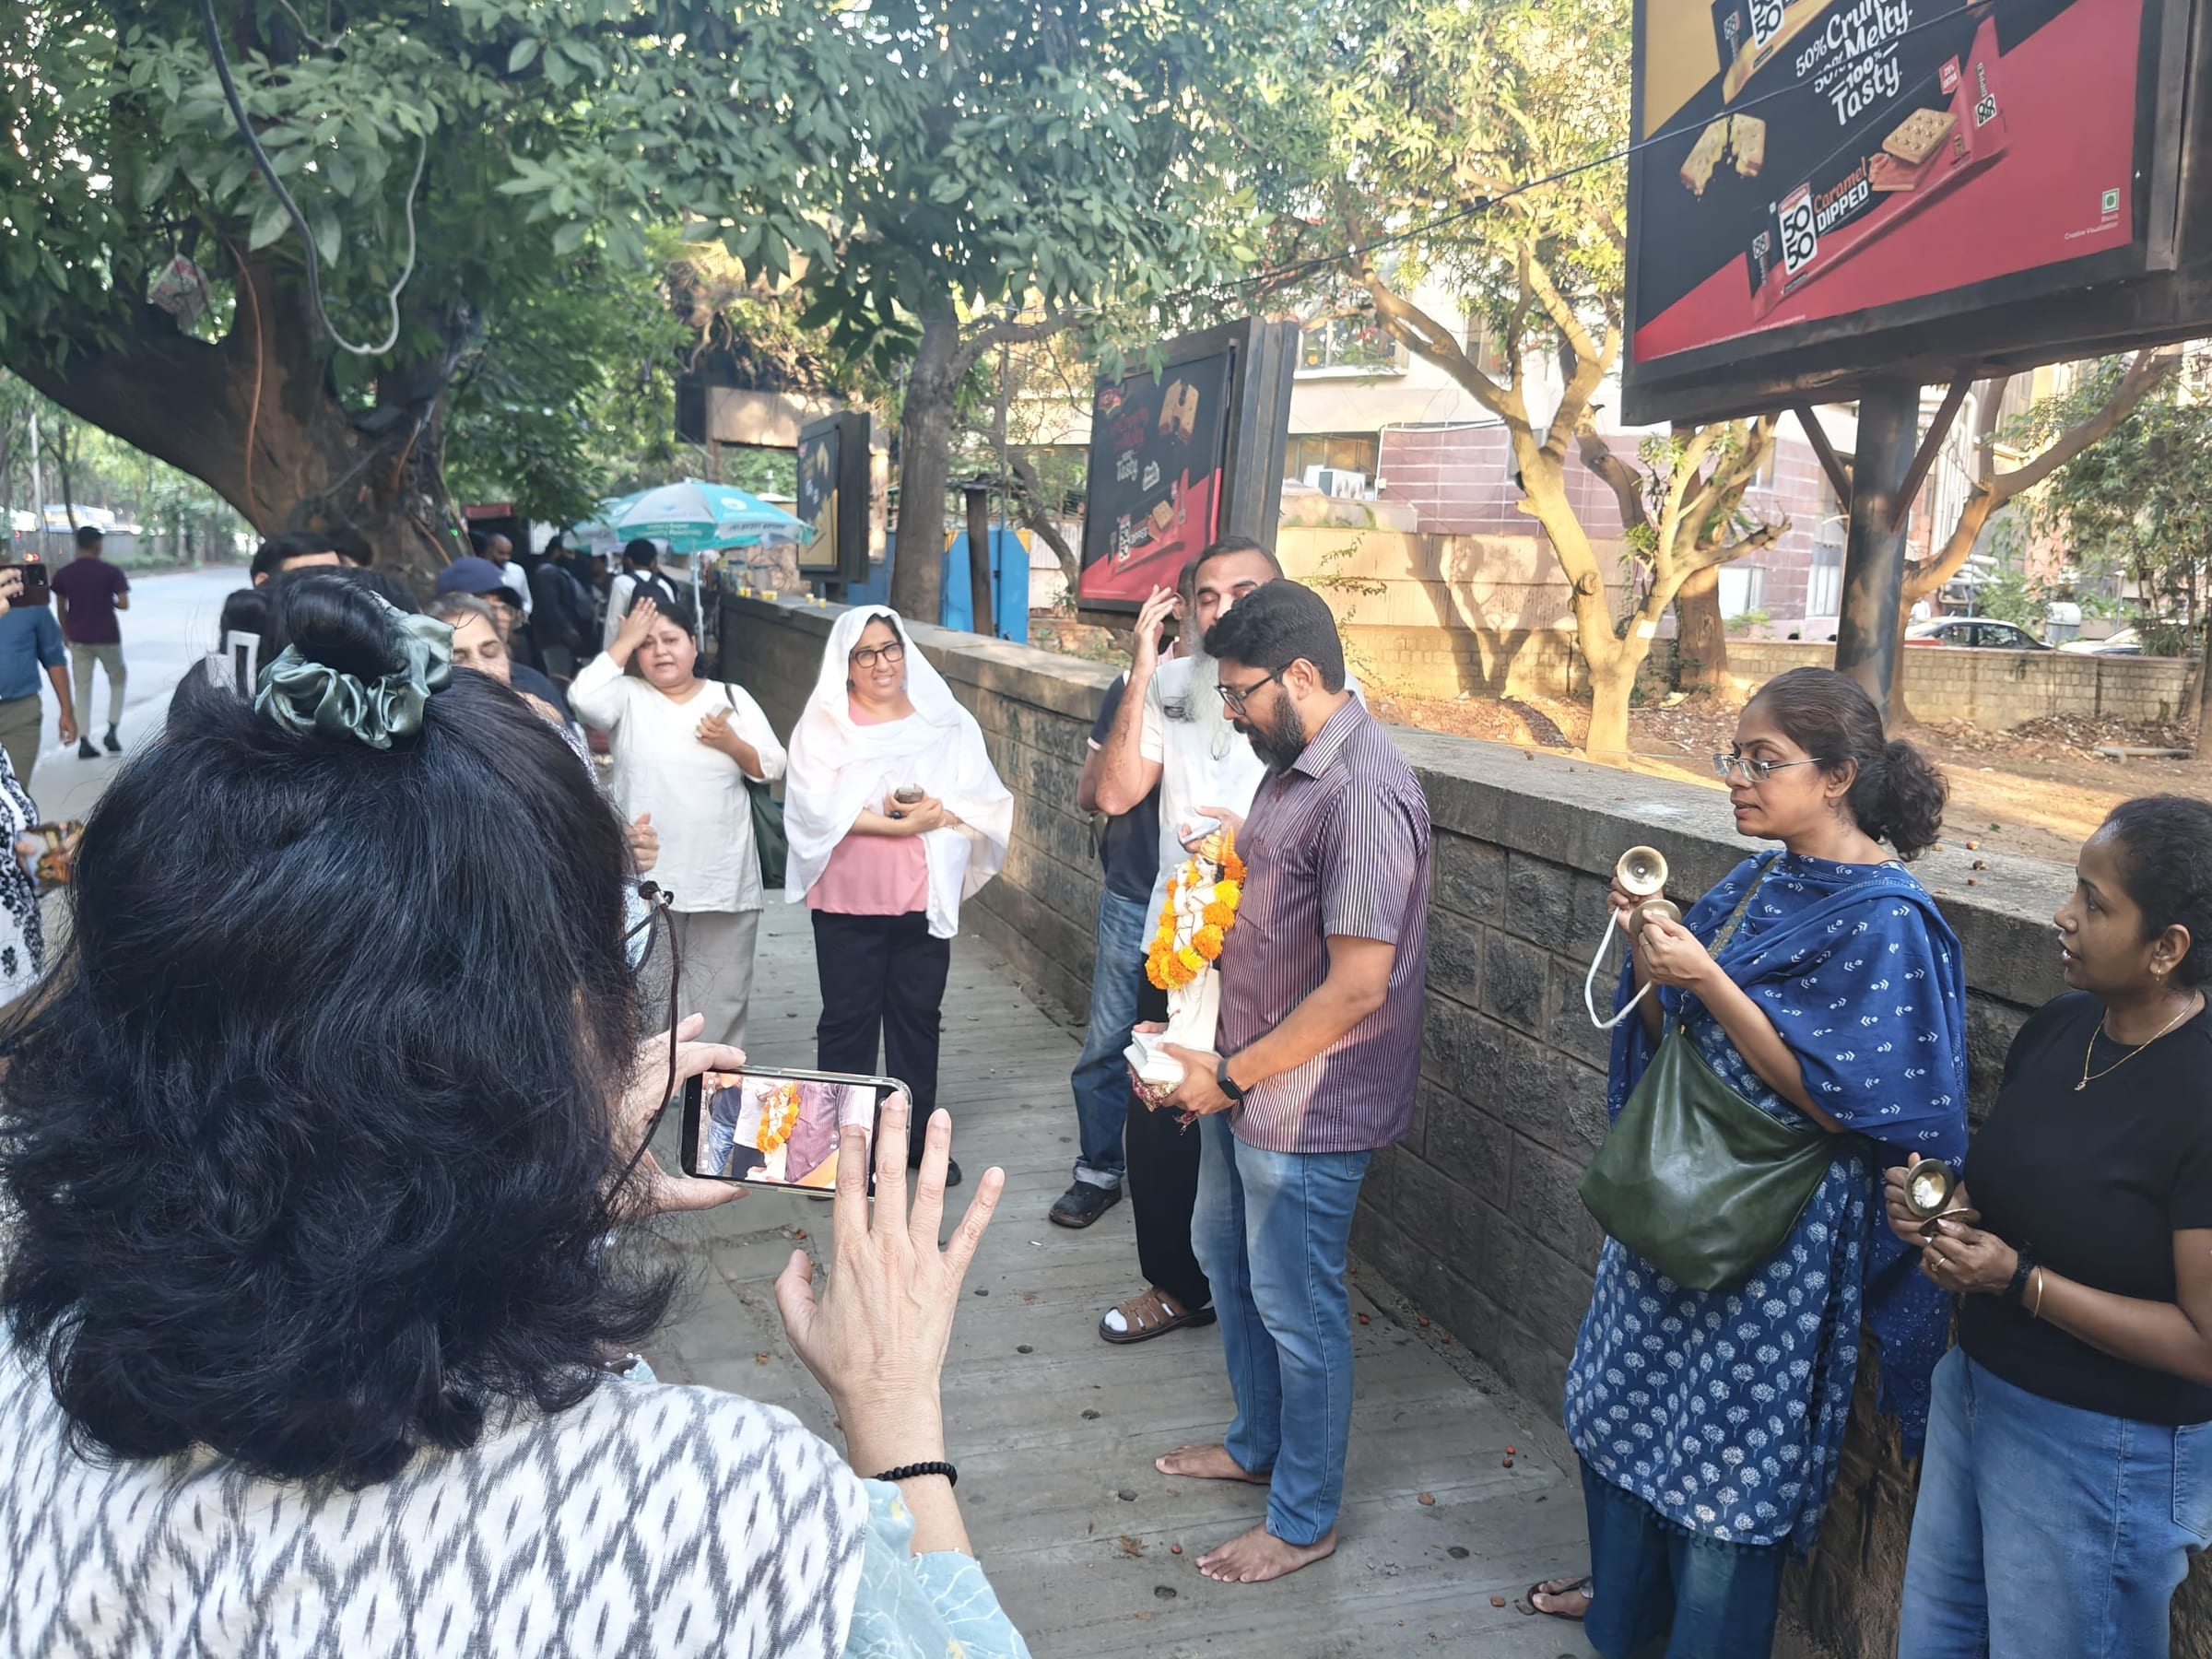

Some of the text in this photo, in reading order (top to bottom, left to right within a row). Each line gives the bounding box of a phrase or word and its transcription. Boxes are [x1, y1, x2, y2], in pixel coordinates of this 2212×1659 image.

[1755, 4, 1783, 44] 50
[1844, 0, 1913, 58] Melty.
[1795, 34, 1828, 77] 50%
[1831, 56, 1903, 125] Tasty.
[1814, 156, 1867, 214] Caramel
[1817, 180, 1869, 232] DIPPED
[1783, 205, 1811, 244] 50
[1786, 231, 1815, 271] 50
